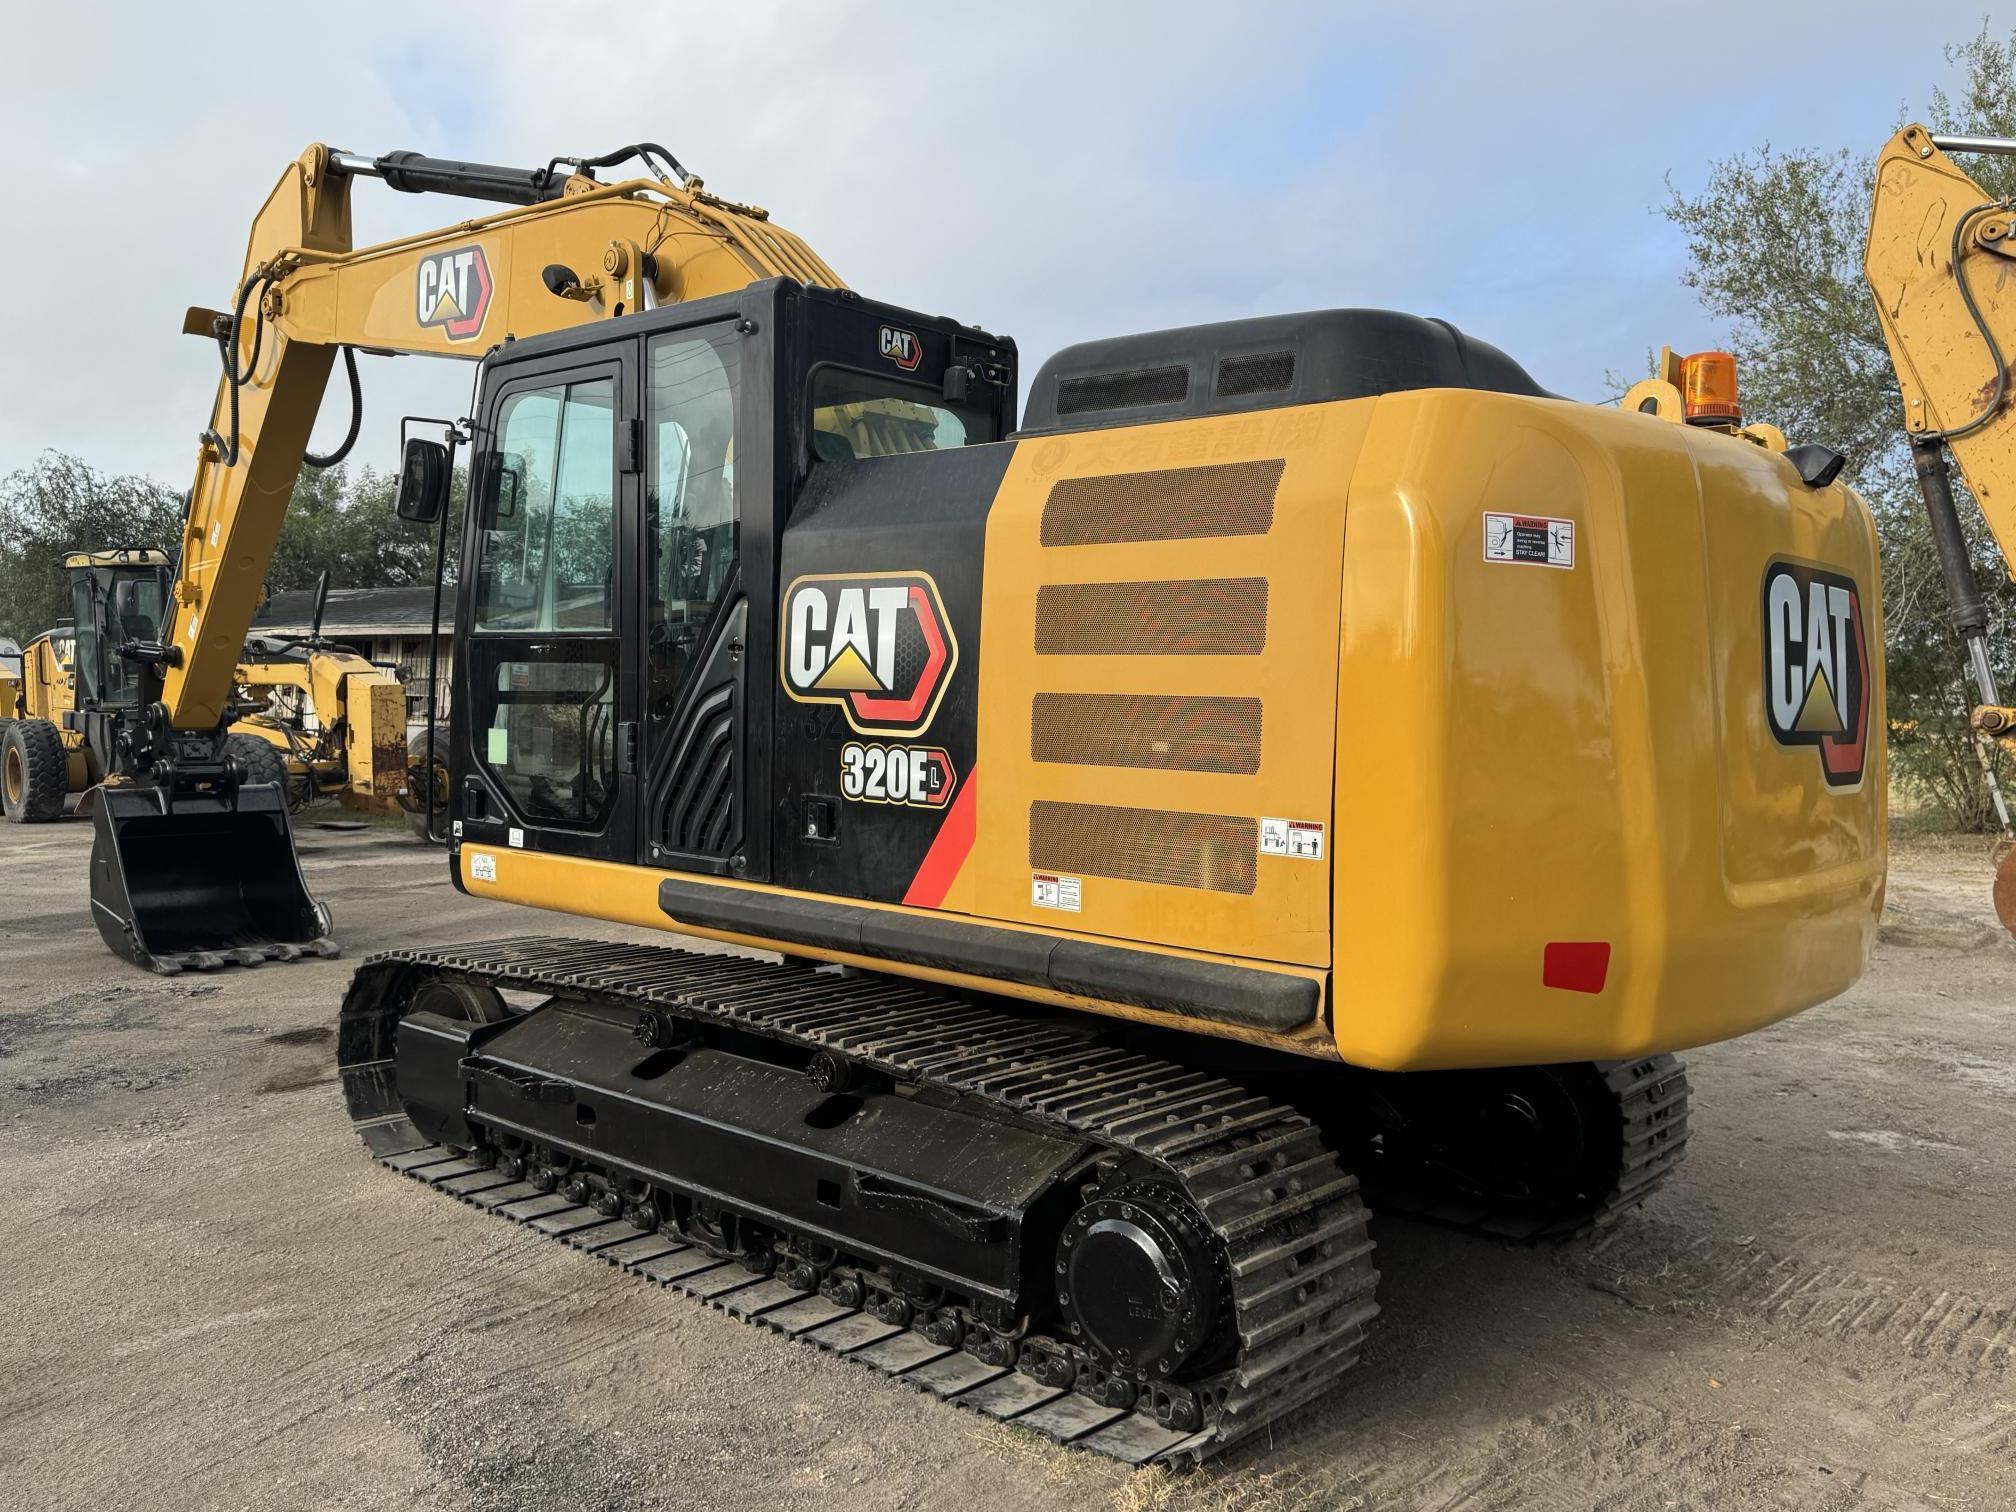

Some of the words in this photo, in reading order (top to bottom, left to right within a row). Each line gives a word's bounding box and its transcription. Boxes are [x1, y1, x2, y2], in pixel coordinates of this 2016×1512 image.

[420, 252, 473, 322] CAT
[881, 328, 912, 359] CAT
[1522, 520, 1547, 528] WARNING
[60, 639, 76, 664] CAT
[790, 586, 908, 691] CAT
[1769, 574, 1851, 731] CAT
[844, 746, 928, 801] 320E
[1296, 822, 1323, 831] WARNING
[1039, 875, 1058, 883] WARNING
